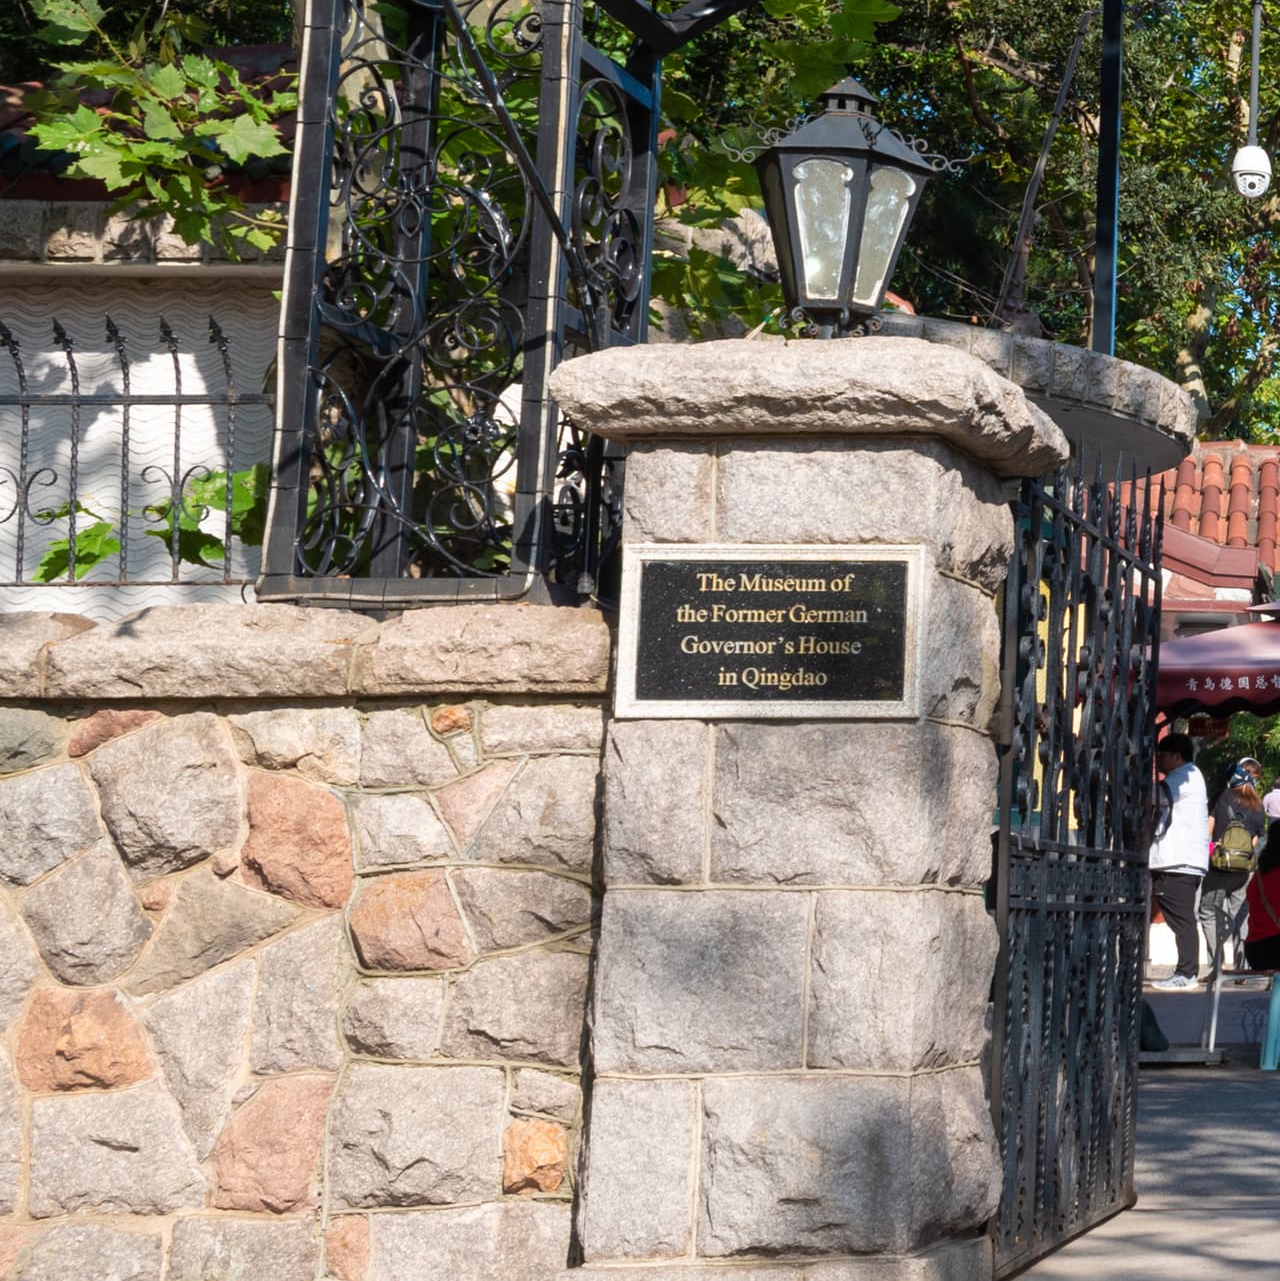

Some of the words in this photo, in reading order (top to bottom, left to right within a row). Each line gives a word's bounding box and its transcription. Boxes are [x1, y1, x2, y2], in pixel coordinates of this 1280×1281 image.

[696, 573, 736, 592] The
[739, 574, 827, 592] Museum
[830, 573, 855, 592] of
[676, 604, 709, 623] the
[711, 605, 787, 623] Former
[789, 605, 868, 624] German
[680, 636, 795, 655] Governor’s
[797, 637, 863, 655] House
[717, 667, 738, 686] in
[741, 667, 828, 690] Qingdao
